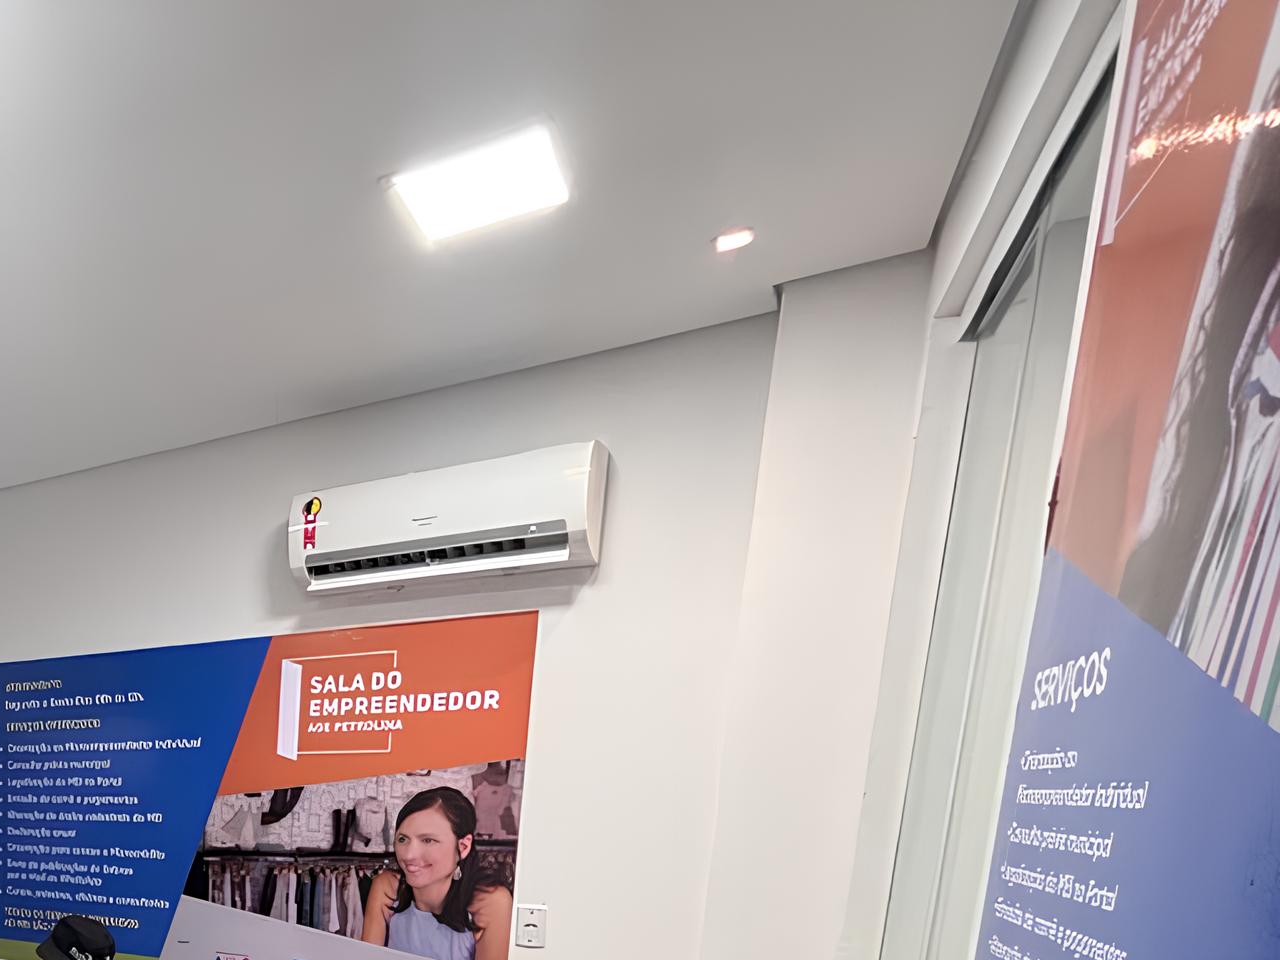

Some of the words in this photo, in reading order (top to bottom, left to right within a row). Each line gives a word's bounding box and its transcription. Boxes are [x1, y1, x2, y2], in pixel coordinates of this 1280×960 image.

[310, 672, 365, 694] SALA
[371, 670, 402, 691] DO
[309, 689, 500, 717] EMPREENDEDOR
